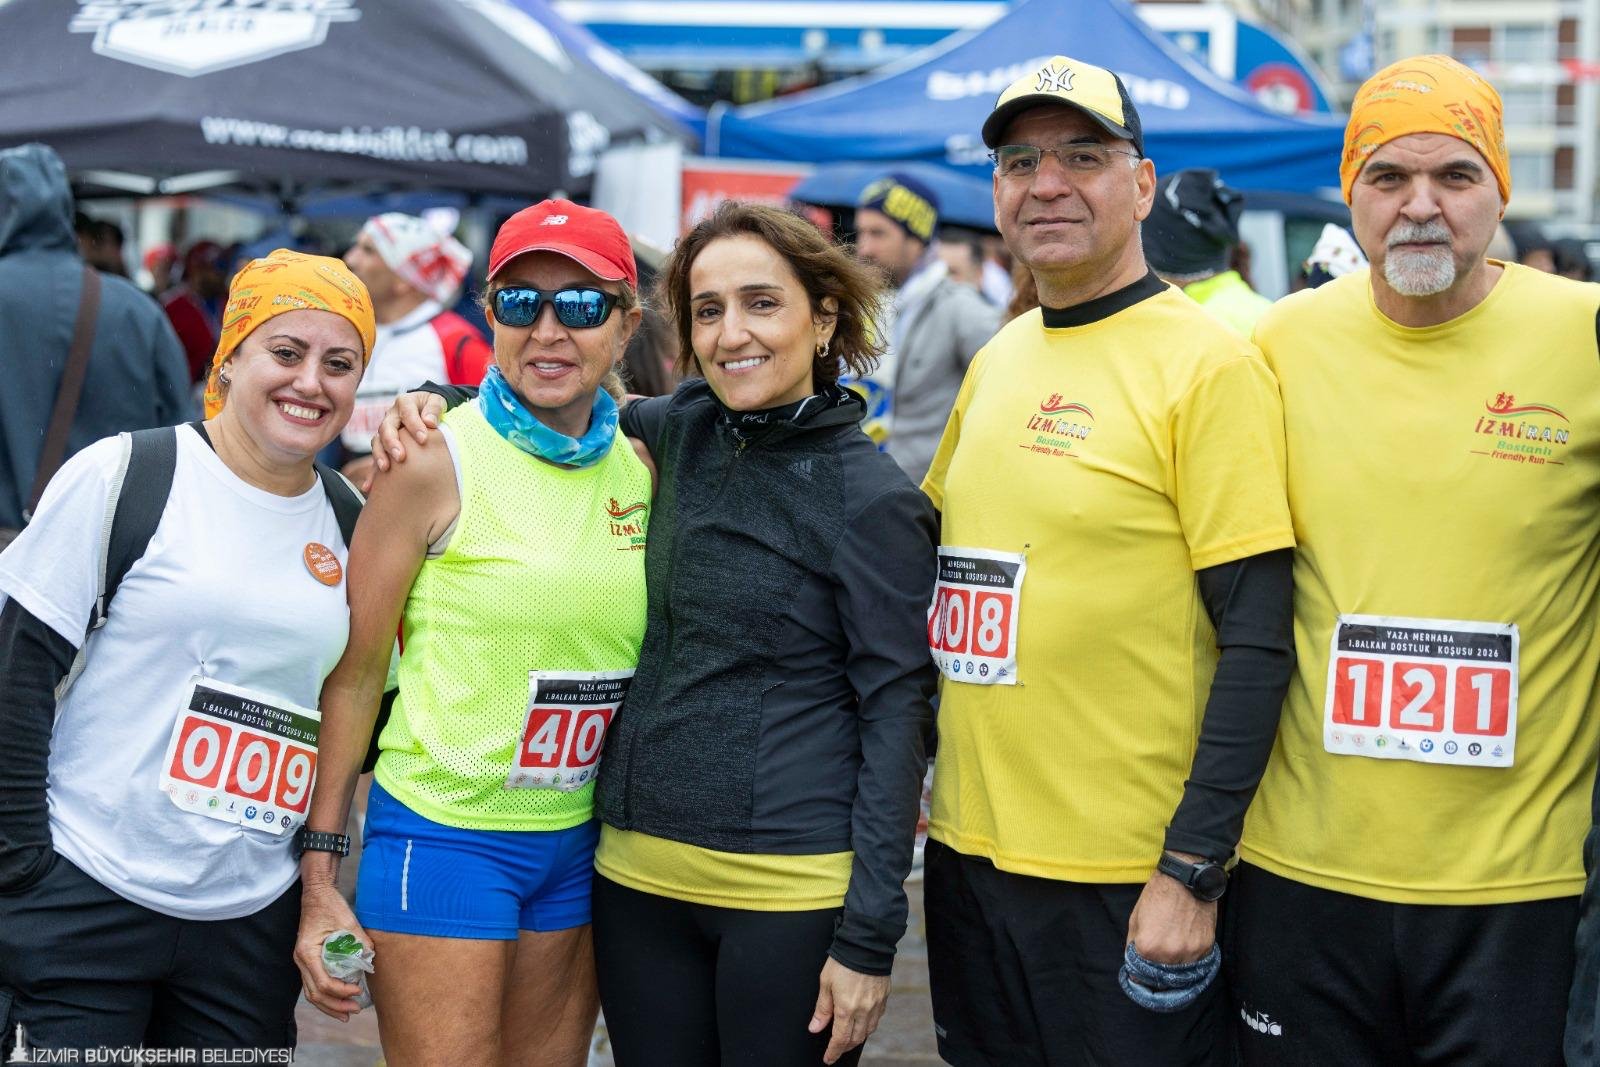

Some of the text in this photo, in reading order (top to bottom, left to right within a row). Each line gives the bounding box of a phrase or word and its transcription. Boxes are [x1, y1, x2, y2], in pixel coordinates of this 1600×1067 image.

[1475, 416, 1569, 444] İZMİRAN
[1492, 451, 1545, 464] Friendly Run
[990, 575, 1005, 583] 2026
[1387, 630, 1454, 643] YAZA MERHABA
[1348, 639, 1499, 658] 1.BALKAN DOSTLUK KOŞUSU 2026
[578, 682, 622, 691] YAZA MERHABA
[580, 693, 607, 701] DOSTLUK
[1348, 664, 1493, 731] 121
[241, 701, 293, 724] YAZA MERHABA
[241, 714, 273, 729] DOSTLUK
[277, 724, 301, 738] KOŞUSU
[302, 732, 317, 742] 2026
[182, 725, 311, 806] 009
